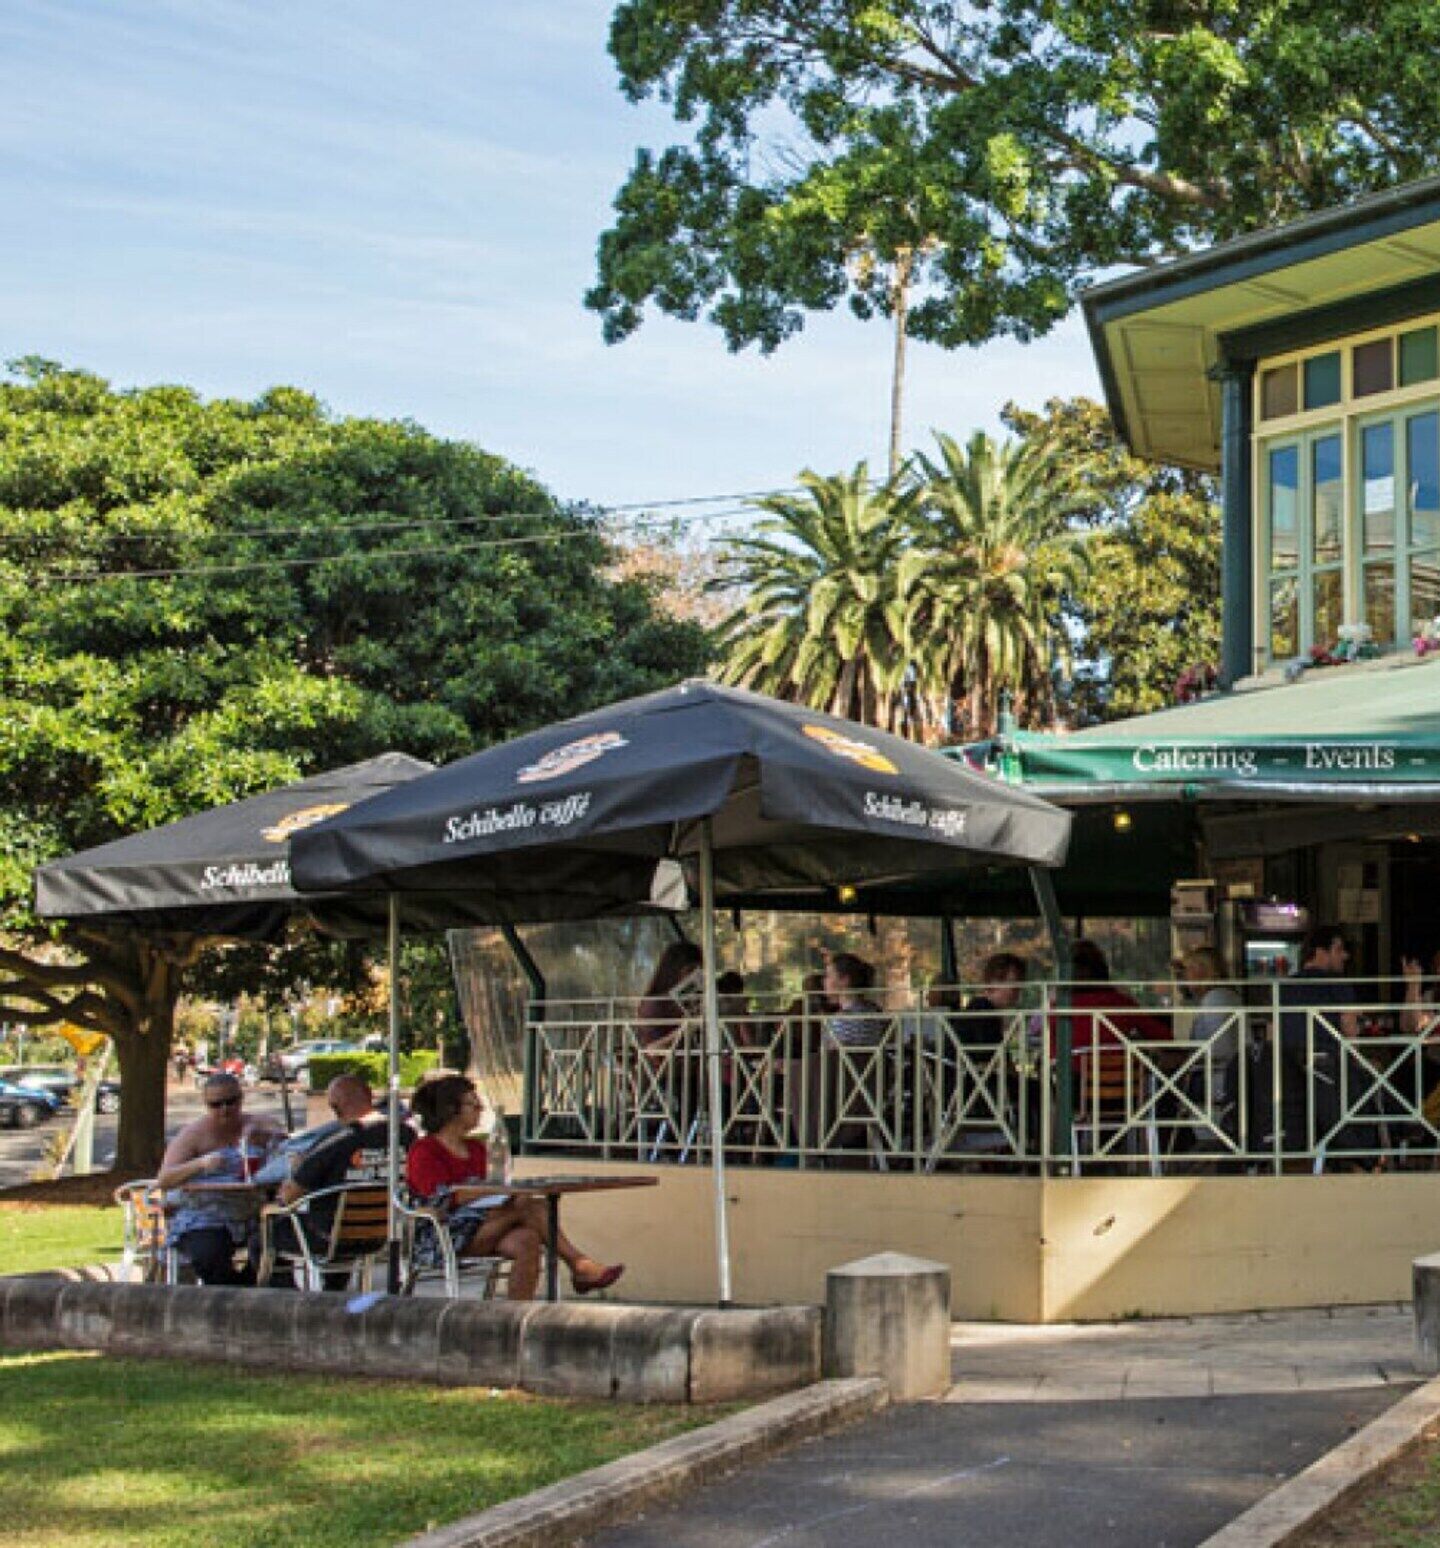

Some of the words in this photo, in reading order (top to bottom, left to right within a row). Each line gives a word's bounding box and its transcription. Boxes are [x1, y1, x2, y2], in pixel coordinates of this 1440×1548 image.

[1132, 742, 1258, 777] Catering
[1305, 743, 1395, 769] Events
[443, 804, 537, 843] Schibello
